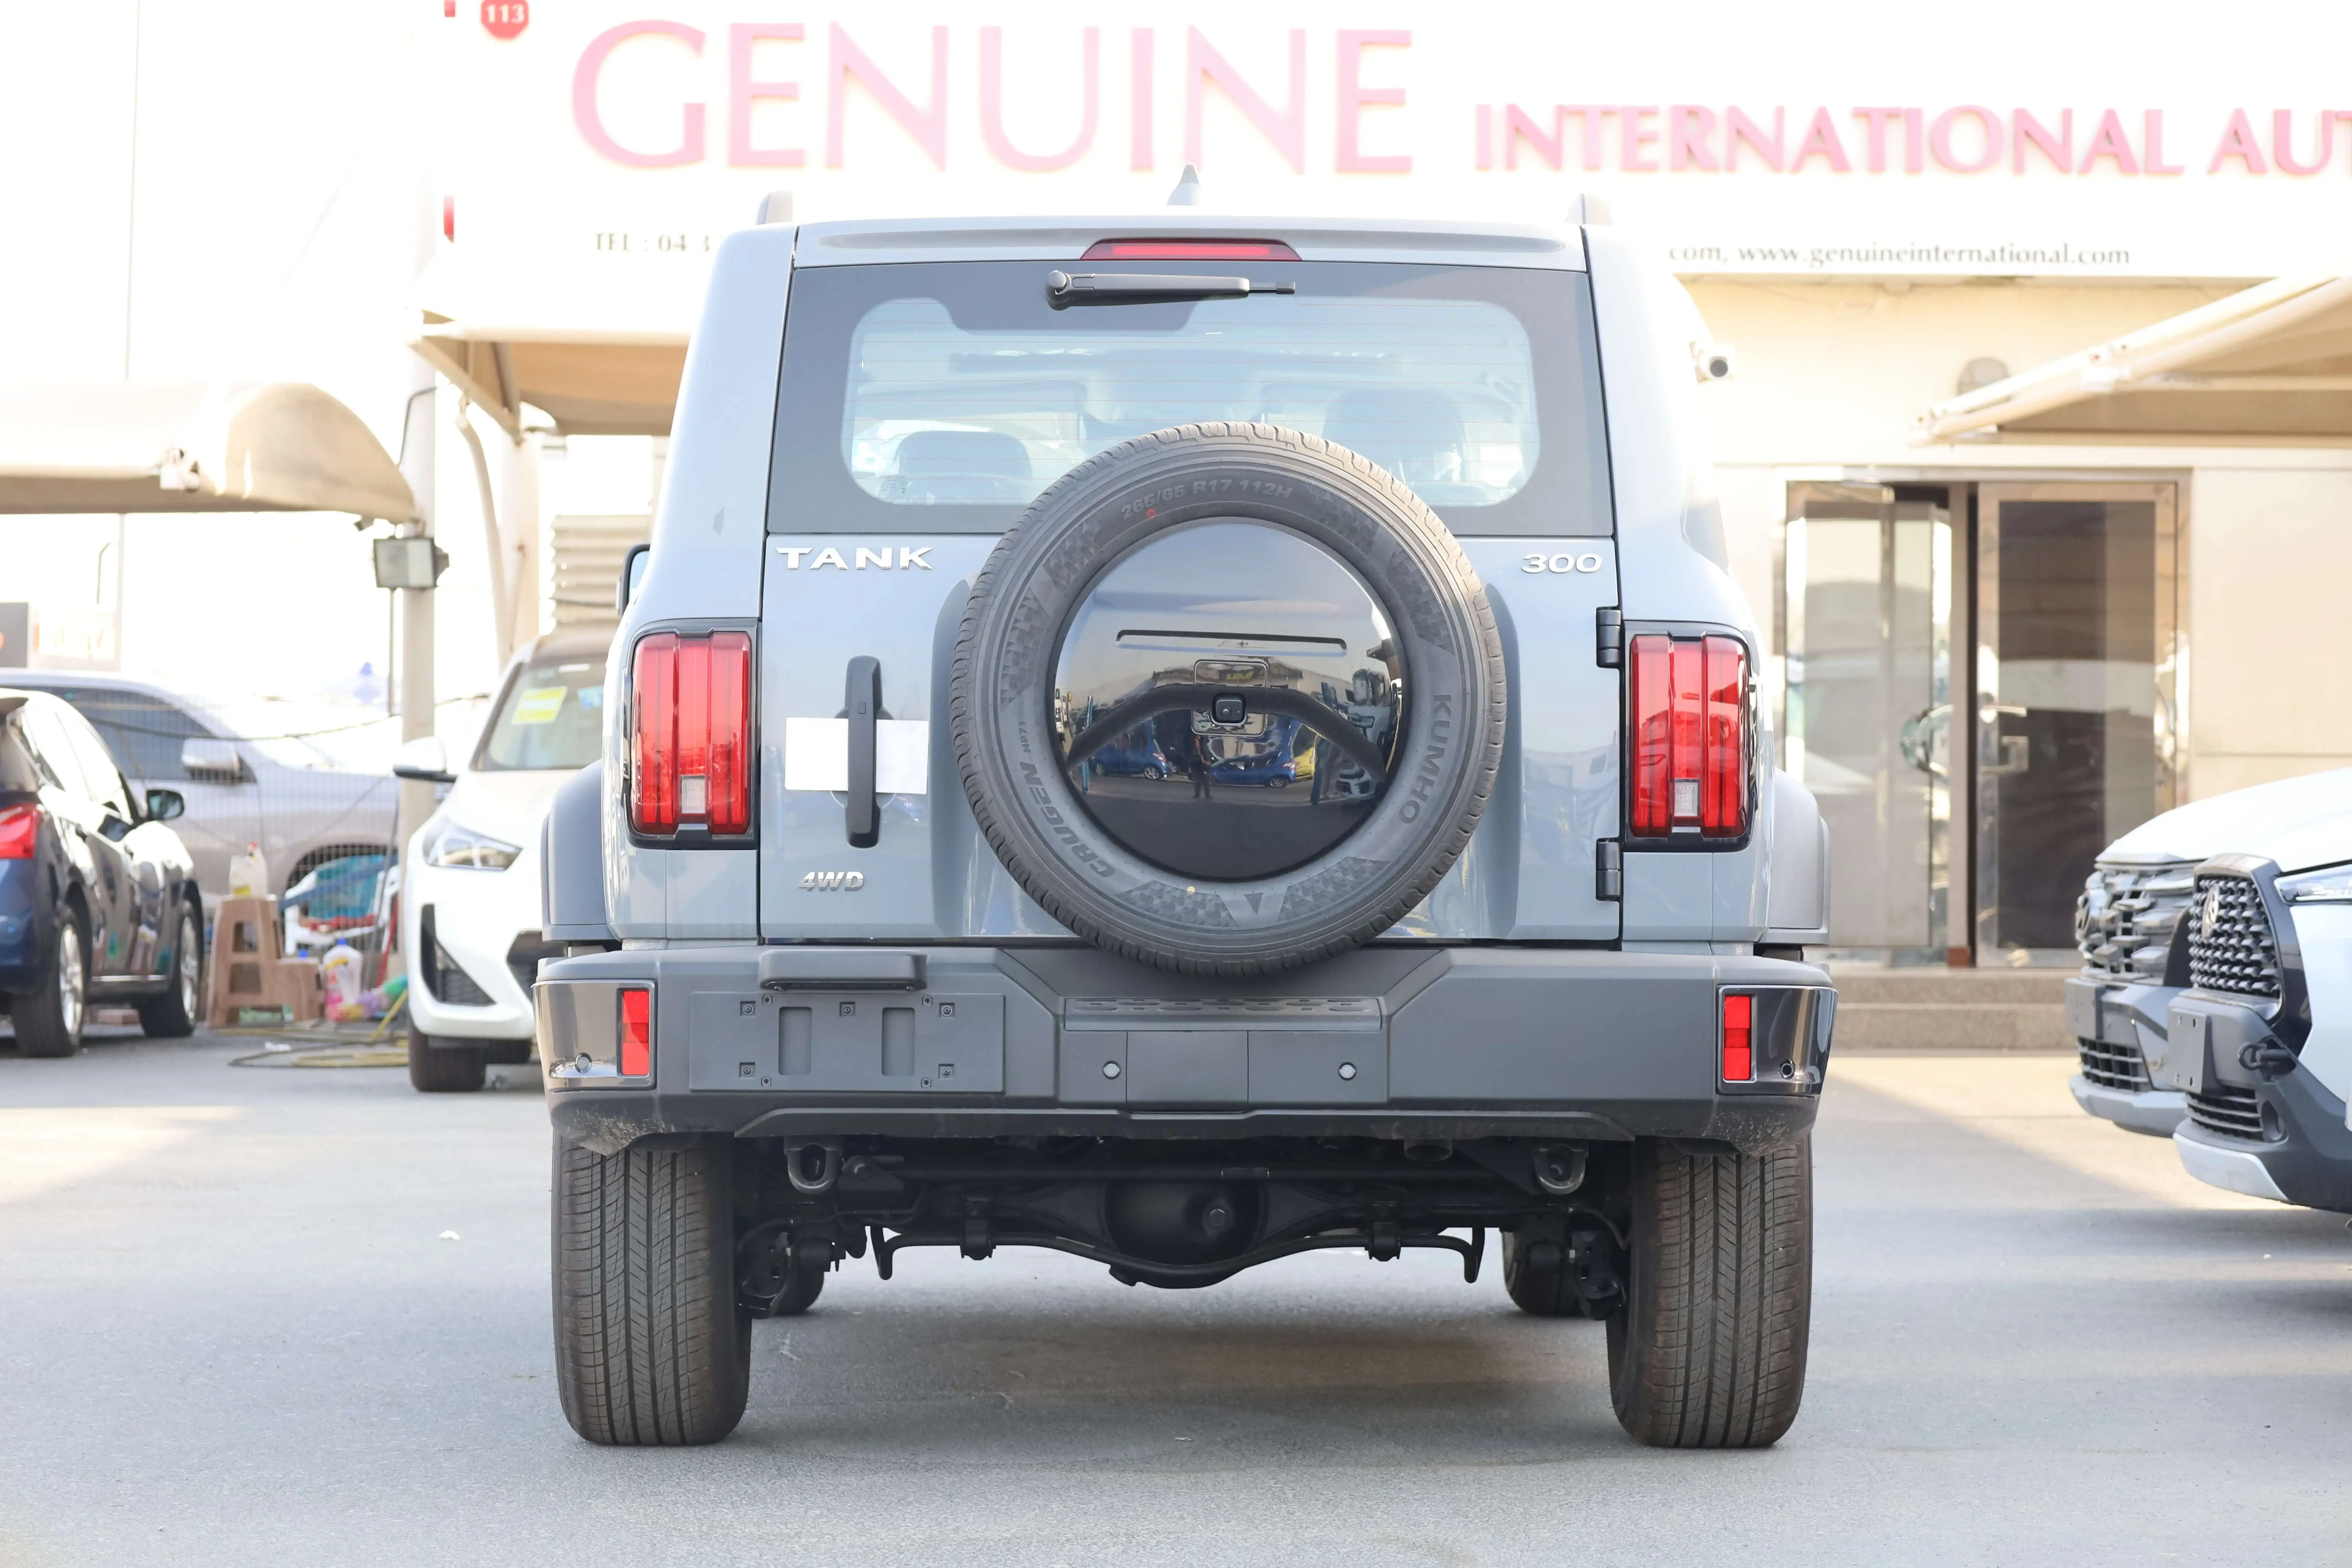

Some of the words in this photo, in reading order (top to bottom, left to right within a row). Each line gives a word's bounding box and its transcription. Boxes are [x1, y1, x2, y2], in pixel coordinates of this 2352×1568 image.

[485, 3, 525, 24] 113
[572, 19, 1413, 174] GENUINE
[1475, 103, 2184, 177] INTERNATIONAL
[657, 233, 692, 252] 04
[1738, 242, 2130, 269] www.genuineinternational.com
[1121, 484, 1186, 520] 265/65
[1193, 479, 1233, 494] R17
[1240, 479, 1292, 499] 112H
[775, 547, 934, 570] TANK
[1521, 553, 1602, 574] 300
[1018, 720, 1031, 753] HP71
[1398, 694, 1452, 824] KUMHO
[1019, 761, 1116, 878] CRUGEN
[798, 871, 864, 892] 4WD
